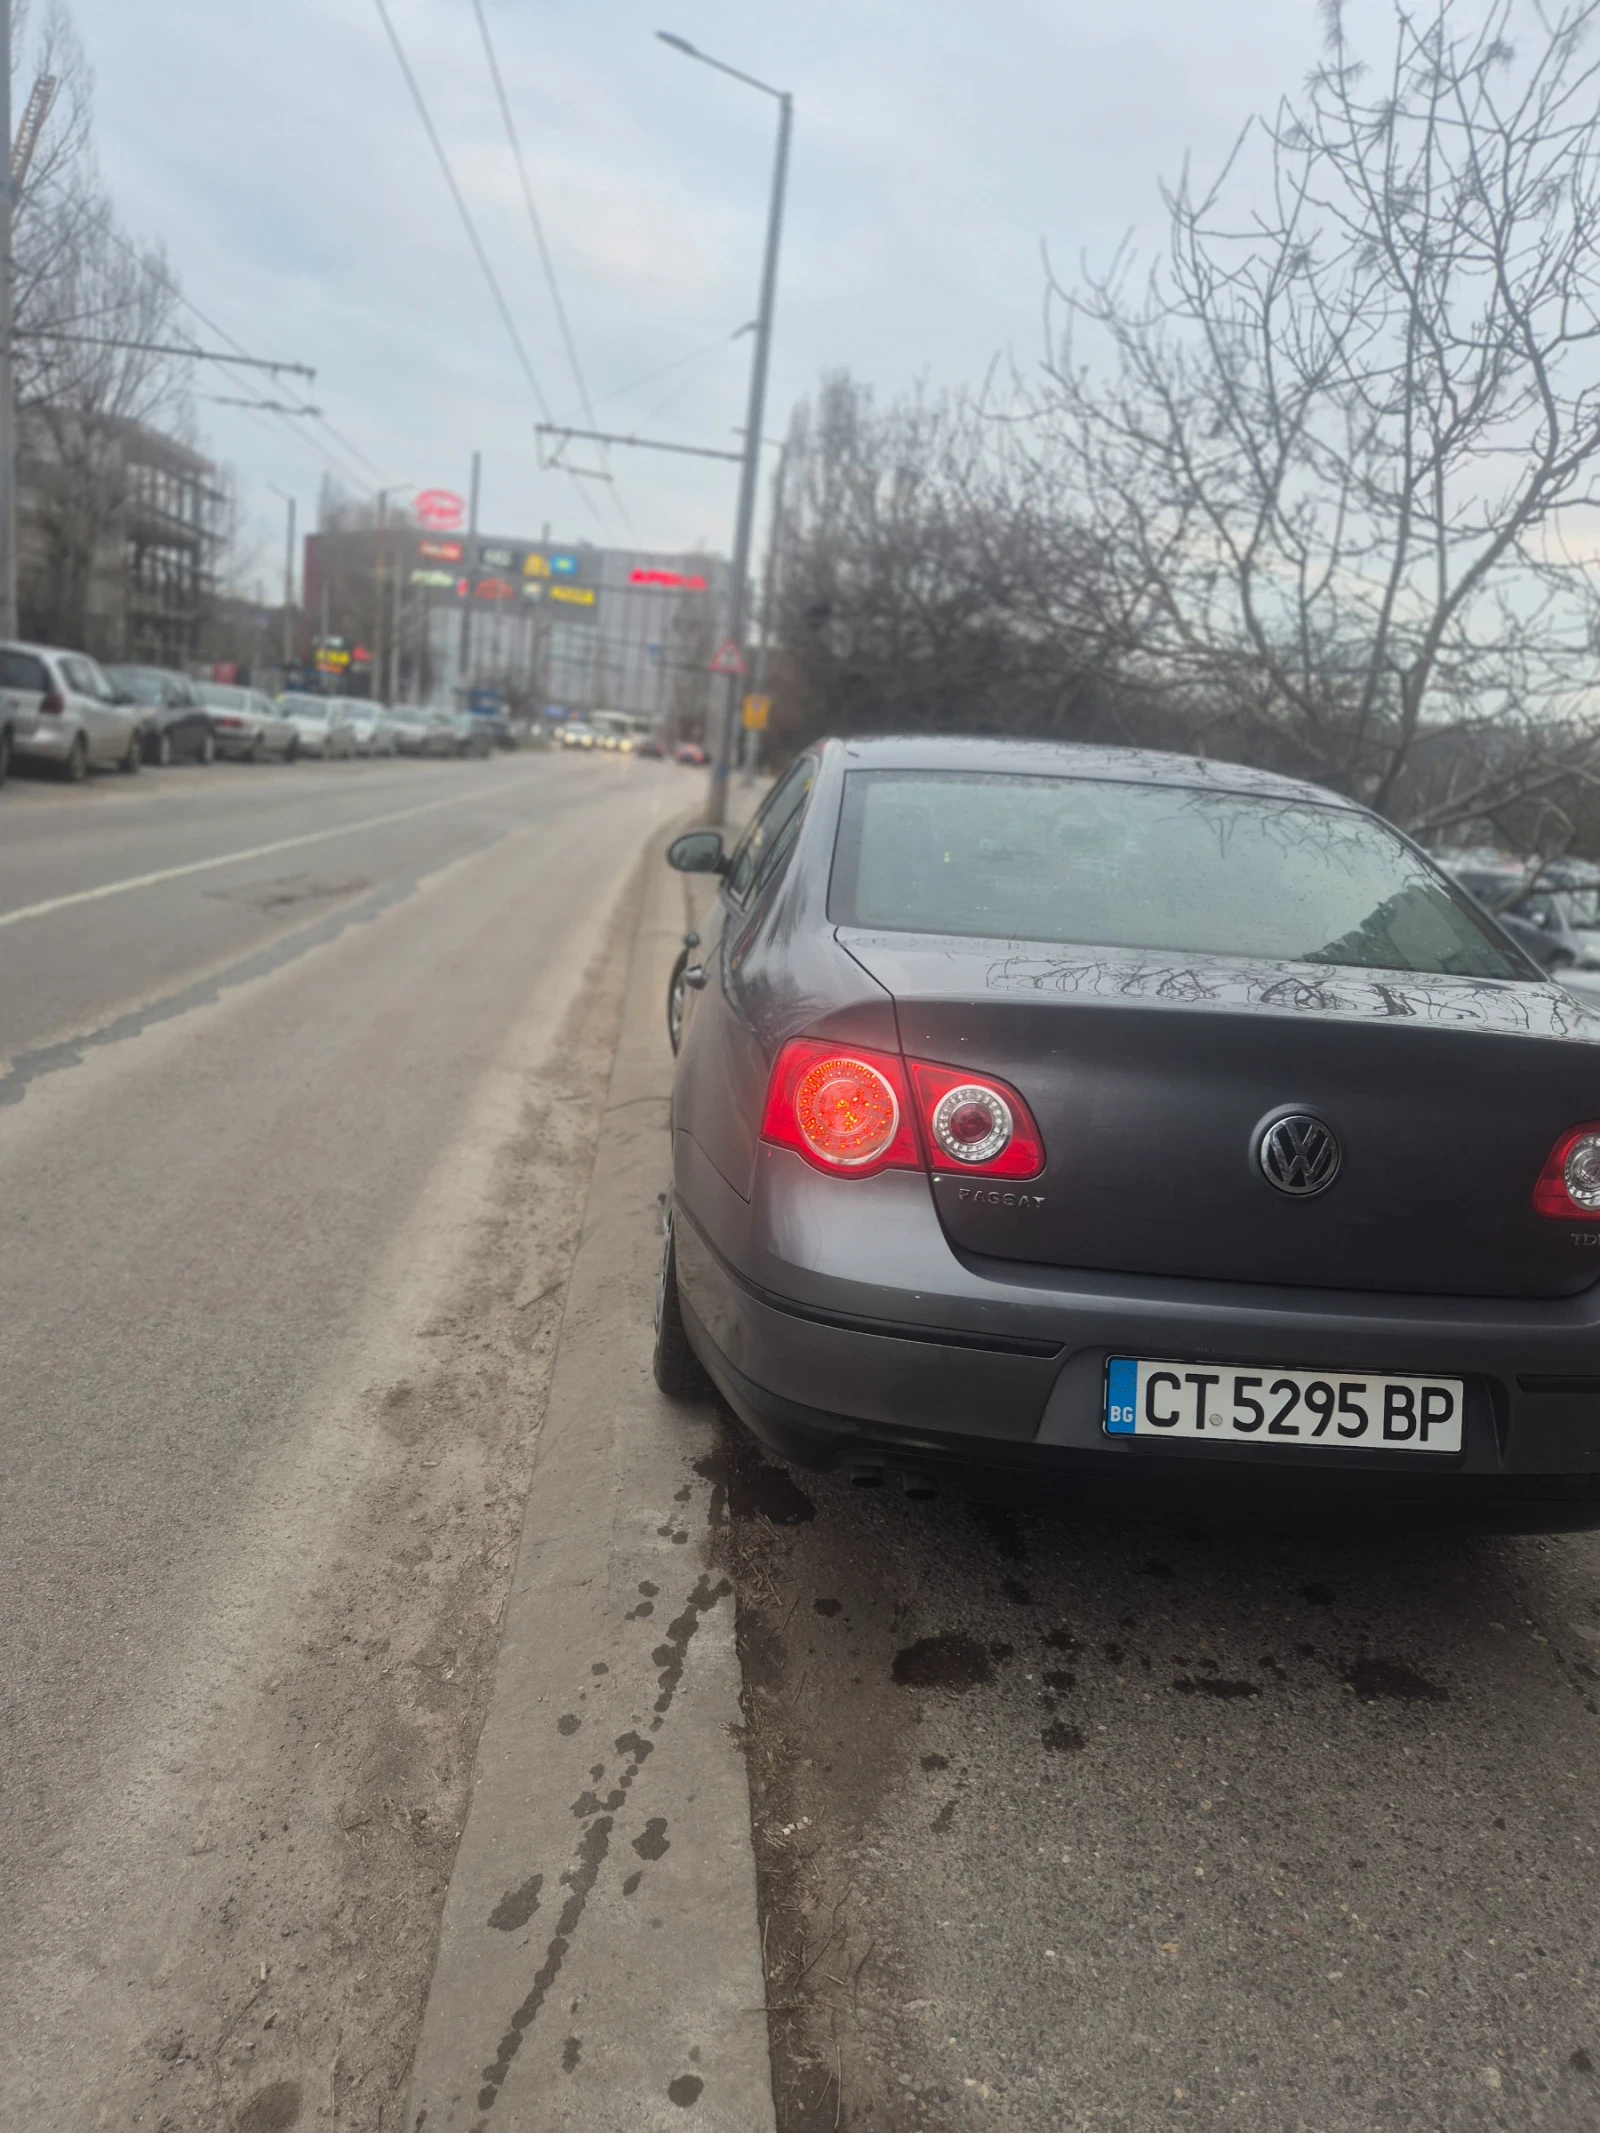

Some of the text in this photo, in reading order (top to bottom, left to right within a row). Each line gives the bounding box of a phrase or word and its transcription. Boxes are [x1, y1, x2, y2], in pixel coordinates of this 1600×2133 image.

[958, 1188, 1046, 1209] PASSAT
[1110, 1405, 1134, 1423] BG
[1144, 1371, 1455, 1442] CT 5295 BP
